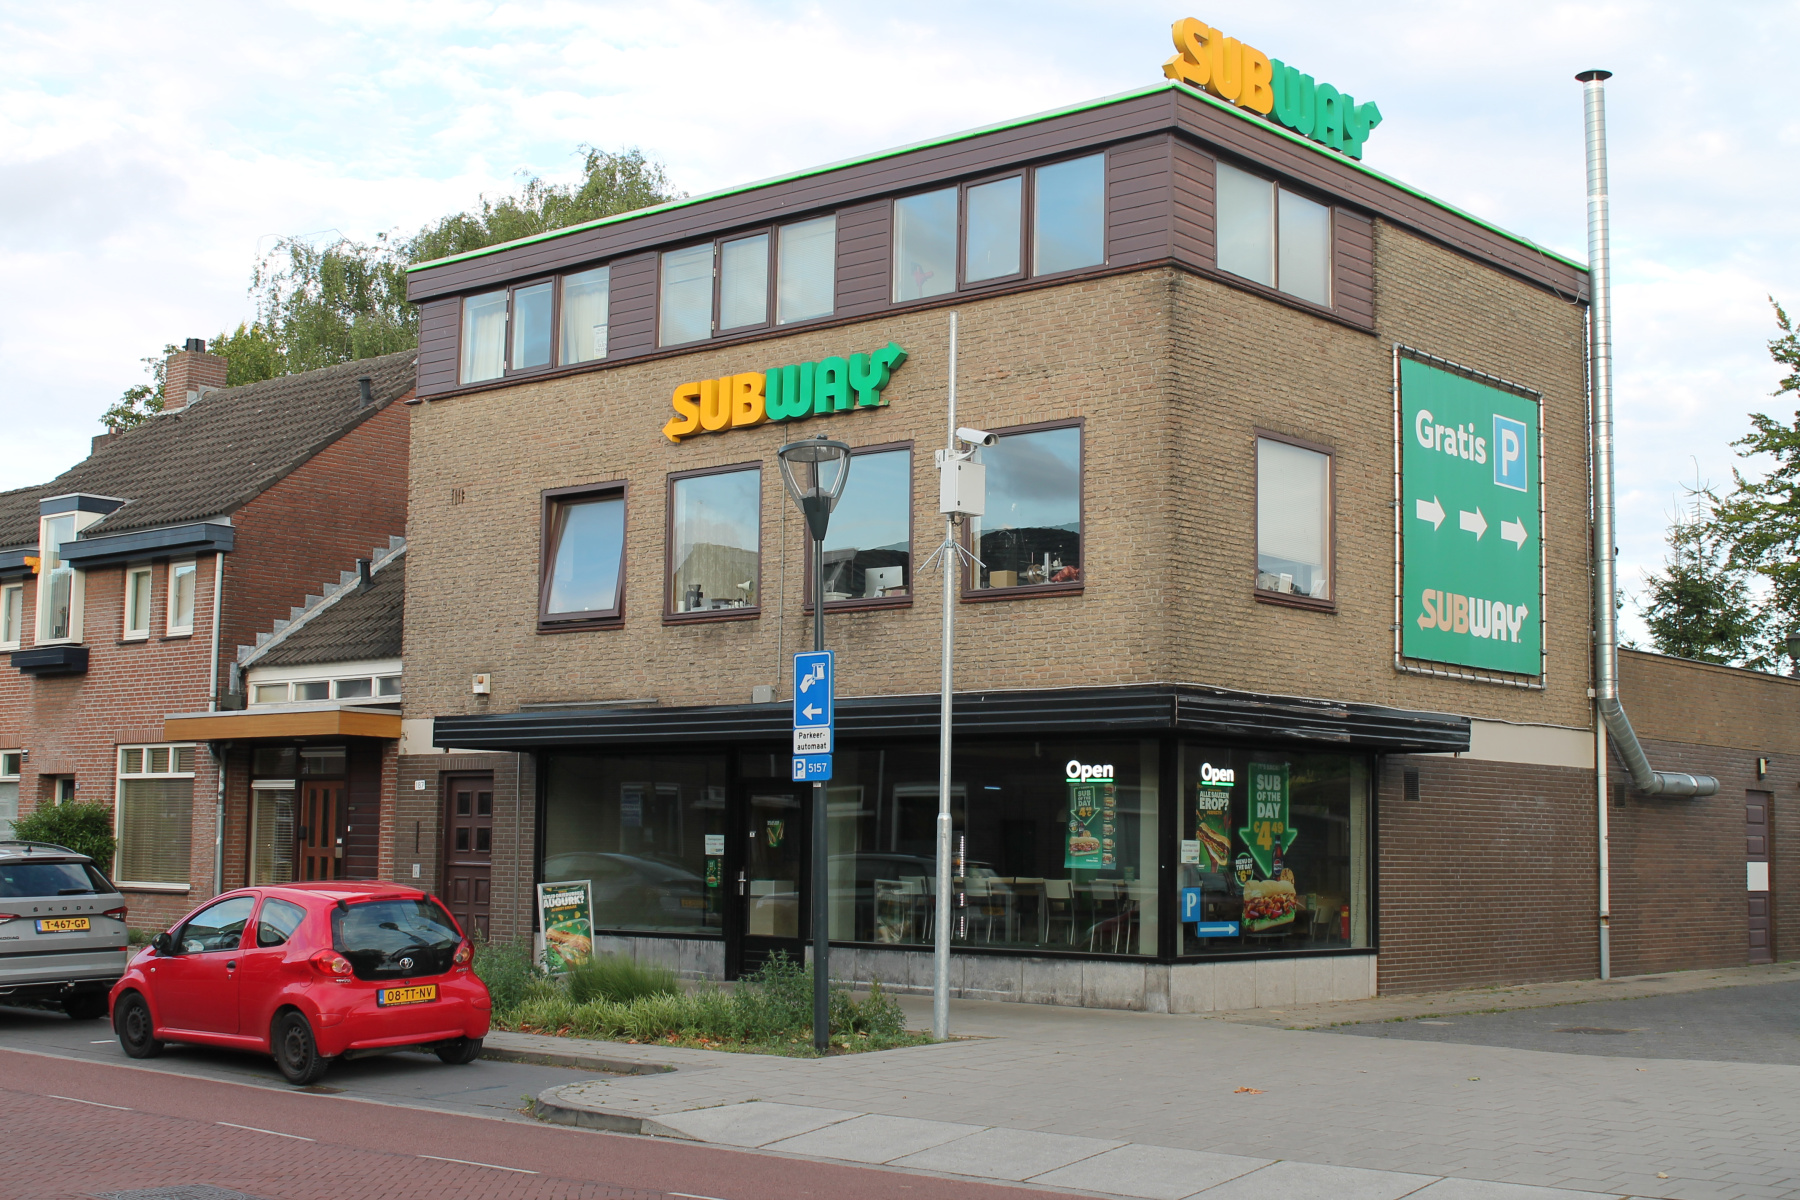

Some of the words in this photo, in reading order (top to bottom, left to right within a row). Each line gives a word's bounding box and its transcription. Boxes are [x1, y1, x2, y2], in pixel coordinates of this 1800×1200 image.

[1162, 17, 1383, 160] SUBWAY
[662, 341, 908, 443] SUBWAY
[1415, 409, 1487, 464] Gratis
[1501, 428, 1520, 477] P
[1417, 588, 1529, 643] SUBWAY
[798, 732, 826, 740] Parkeer-
[797, 742, 827, 750] automaat
[808, 762, 827, 773] 5157
[1066, 760, 1114, 782] Open
[1201, 763, 1235, 785] Open
[416, 781, 425, 789] 187
[1257, 774, 1281, 790] SUB
[1077, 789, 1091, 797] SUB
[1200, 790, 1211, 798] ALLE
[1212, 791, 1229, 799] SAUZEN
[1257, 792, 1266, 800] OF
[1267, 792, 1281, 801] THE
[1200, 798, 1229, 811] EROP?
[1257, 802, 1280, 818] DAY
[544, 896, 585, 909] AUGURK?
[1187, 893, 1196, 917] P
[45, 919, 86, 930] T-467-GP
[387, 987, 433, 1002] 08-TT-NV
